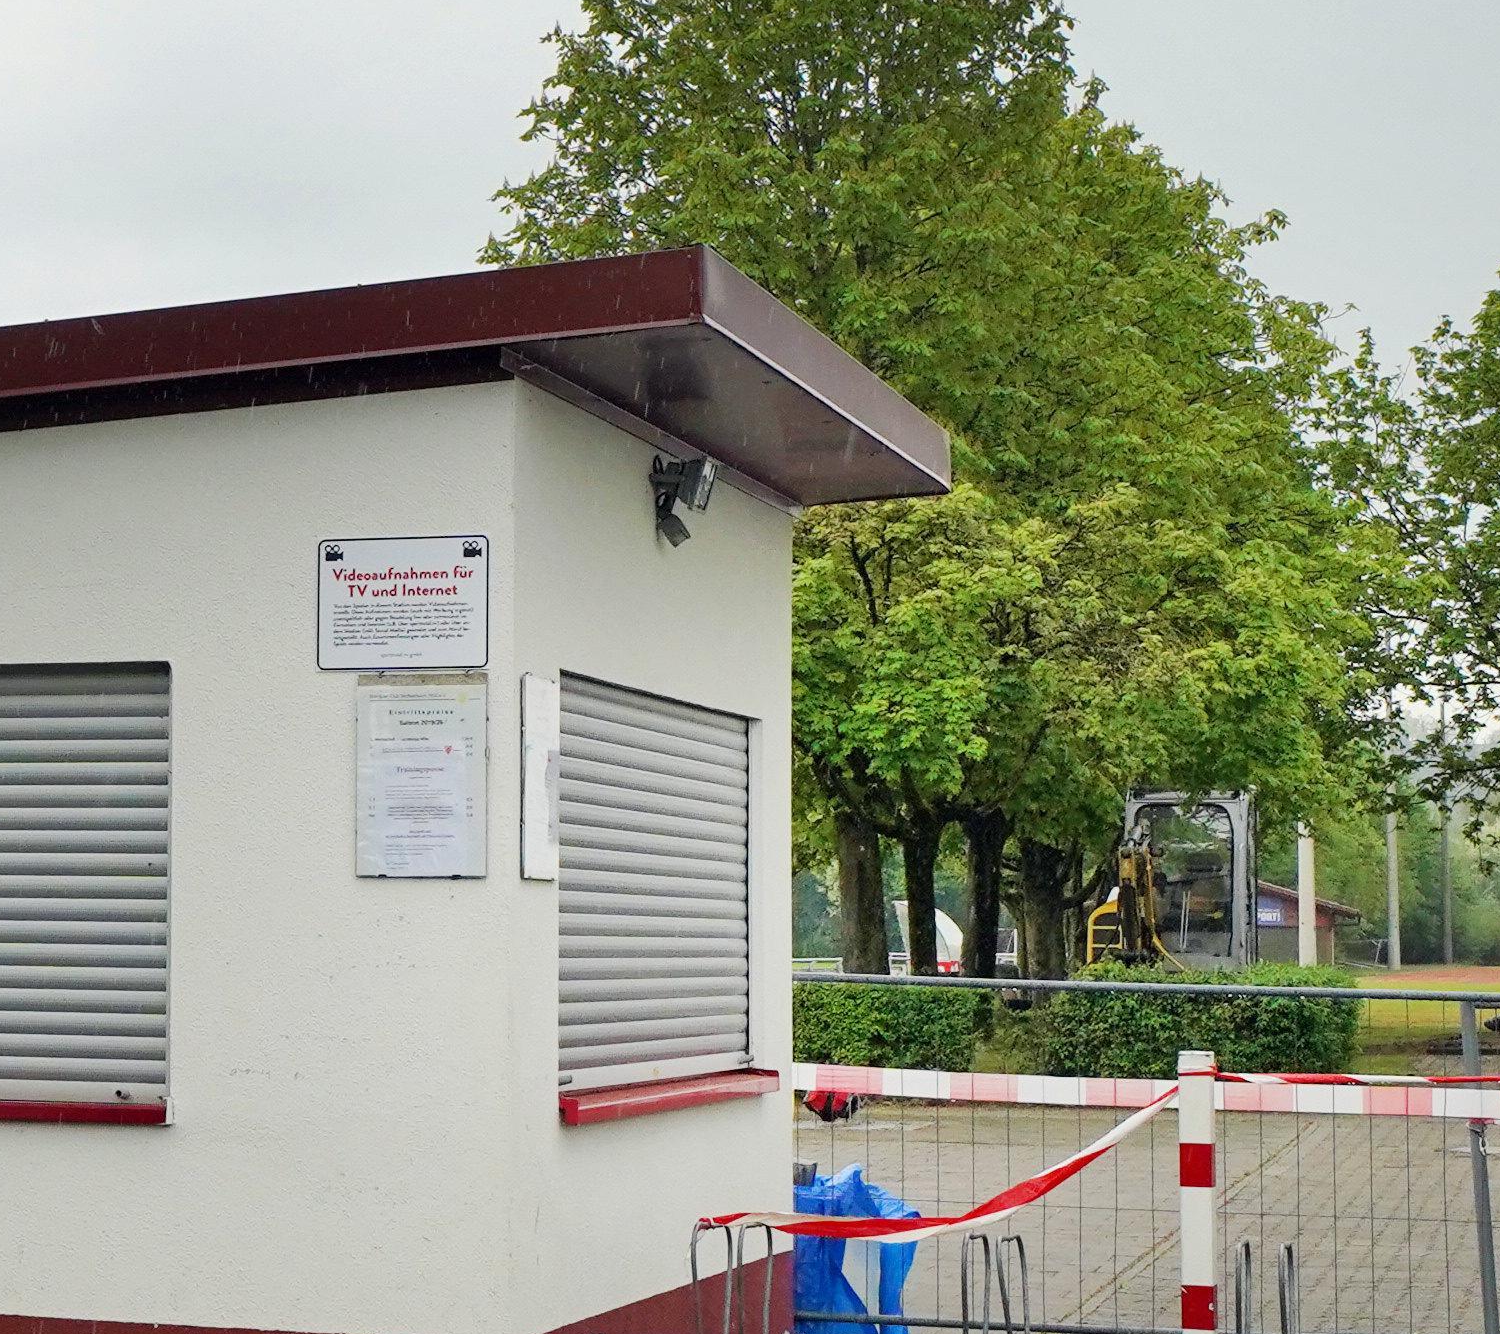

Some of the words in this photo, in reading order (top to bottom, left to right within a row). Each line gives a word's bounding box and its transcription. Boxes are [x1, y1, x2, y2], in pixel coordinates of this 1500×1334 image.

[332, 567, 449, 582] Videoaufnahmen
[453, 565, 475, 579] für
[347, 584, 368, 598] TV
[371, 584, 398, 597] und
[402, 583, 459, 597] Internet
